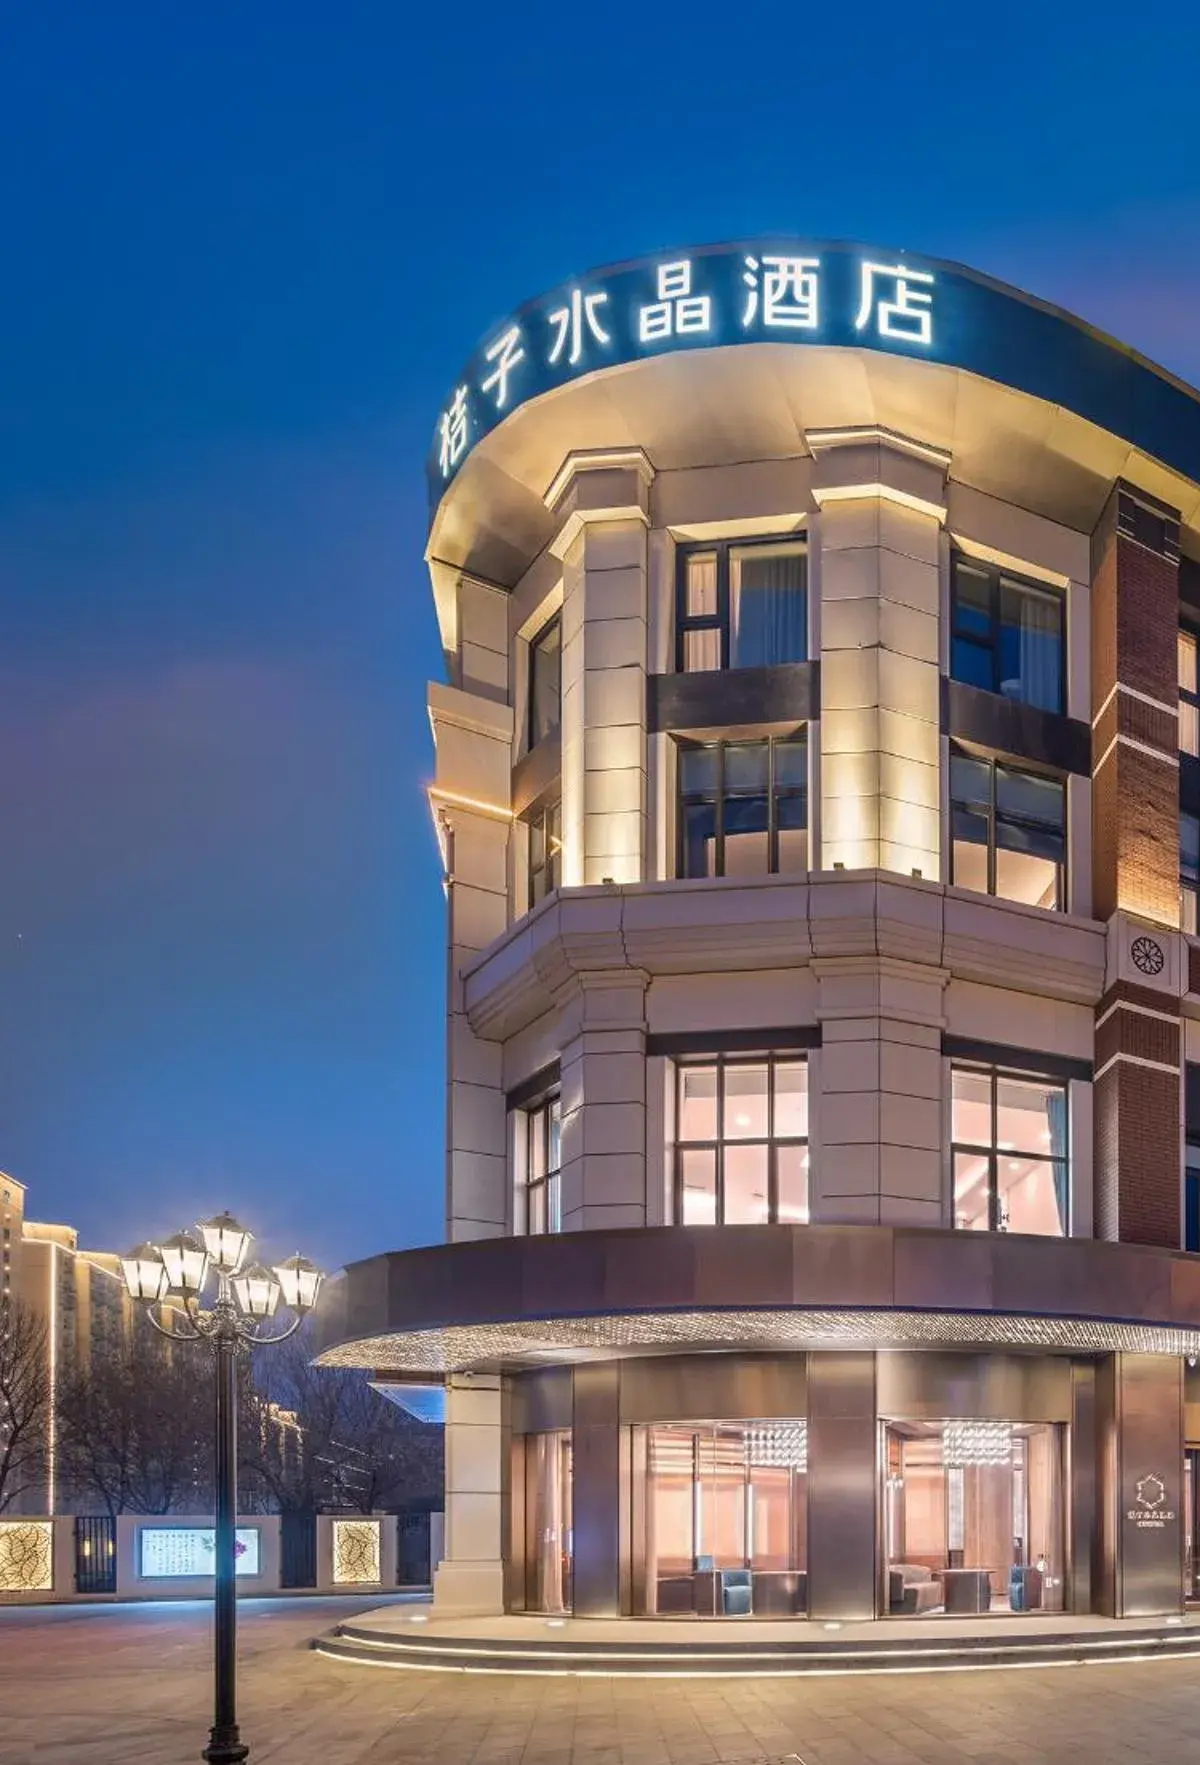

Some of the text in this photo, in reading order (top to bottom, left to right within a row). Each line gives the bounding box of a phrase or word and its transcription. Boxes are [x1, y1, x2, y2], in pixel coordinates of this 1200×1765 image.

[438, 254, 936, 477] 桔子水晶酒店
